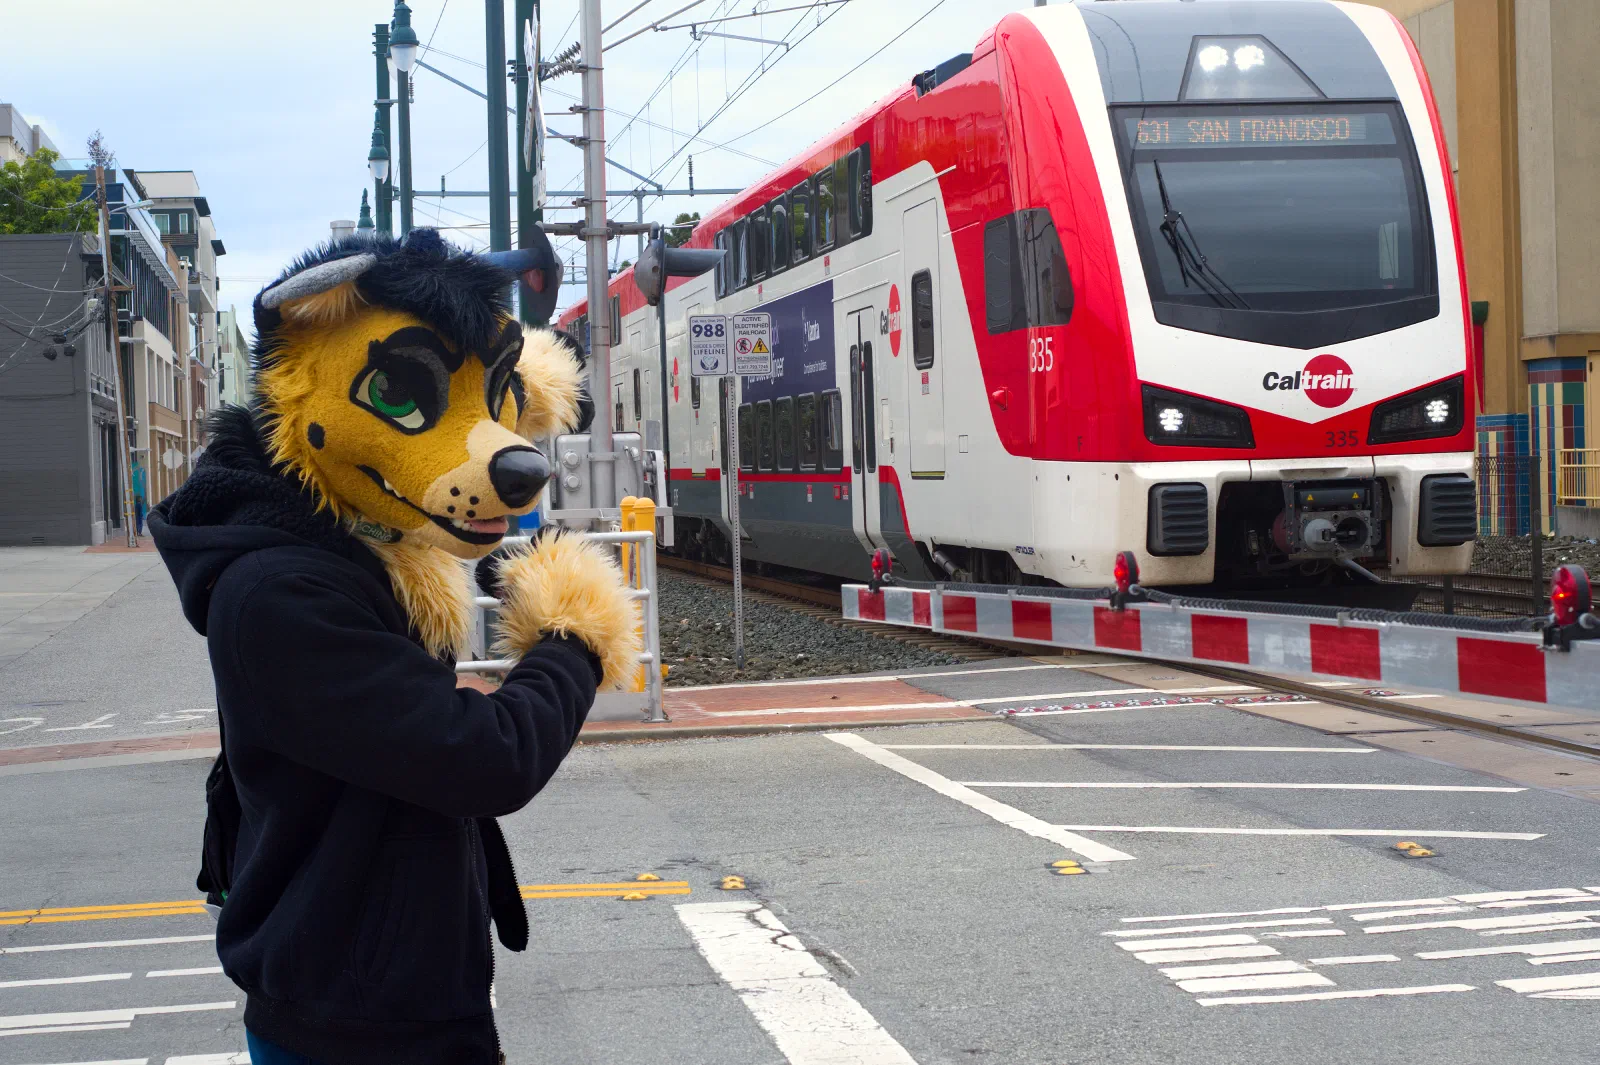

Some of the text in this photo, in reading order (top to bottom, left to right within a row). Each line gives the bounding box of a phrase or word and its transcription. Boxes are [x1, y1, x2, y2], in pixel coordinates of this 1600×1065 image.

[1137, 117, 1350, 144] 631 SAN FRANCISCO
[692, 324, 725, 338] 988
[1029, 337, 1054, 373] 335
[1262, 369, 1354, 391] Caltrain
[1325, 430, 1359, 448] 335
